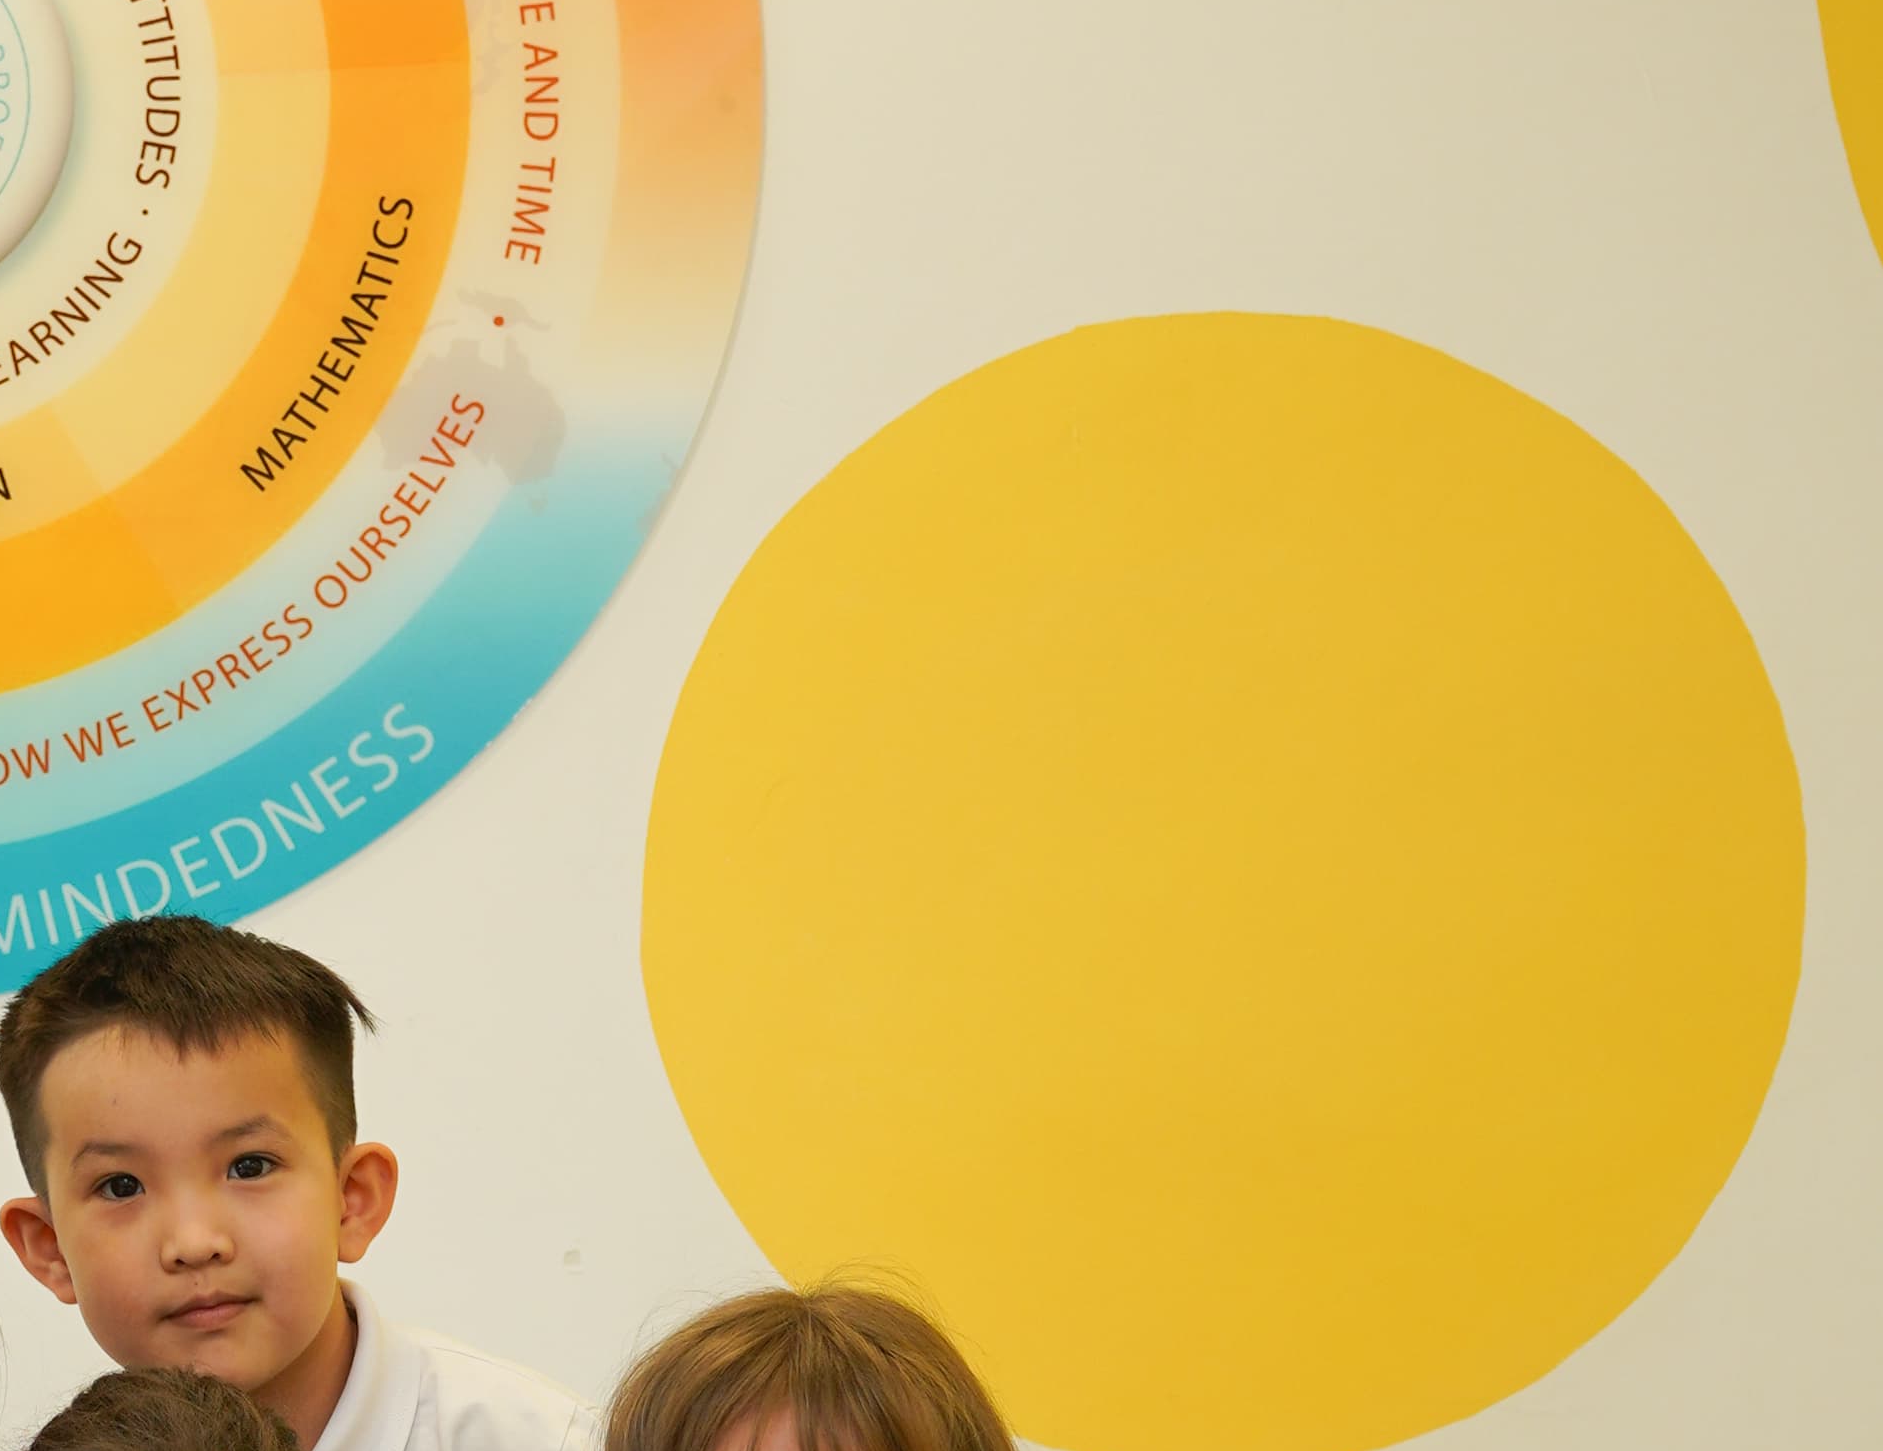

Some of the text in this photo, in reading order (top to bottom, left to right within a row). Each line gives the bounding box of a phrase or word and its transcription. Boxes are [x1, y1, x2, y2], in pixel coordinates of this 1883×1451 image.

[522, 41, 560, 143] AND
[504, 156, 556, 265] TIME
[239, 193, 415, 493] MATHEMATICS
[61, 710, 137, 765] WE
[139, 603, 315, 735] EXPRESS
[313, 392, 486, 611] OURSELVES
